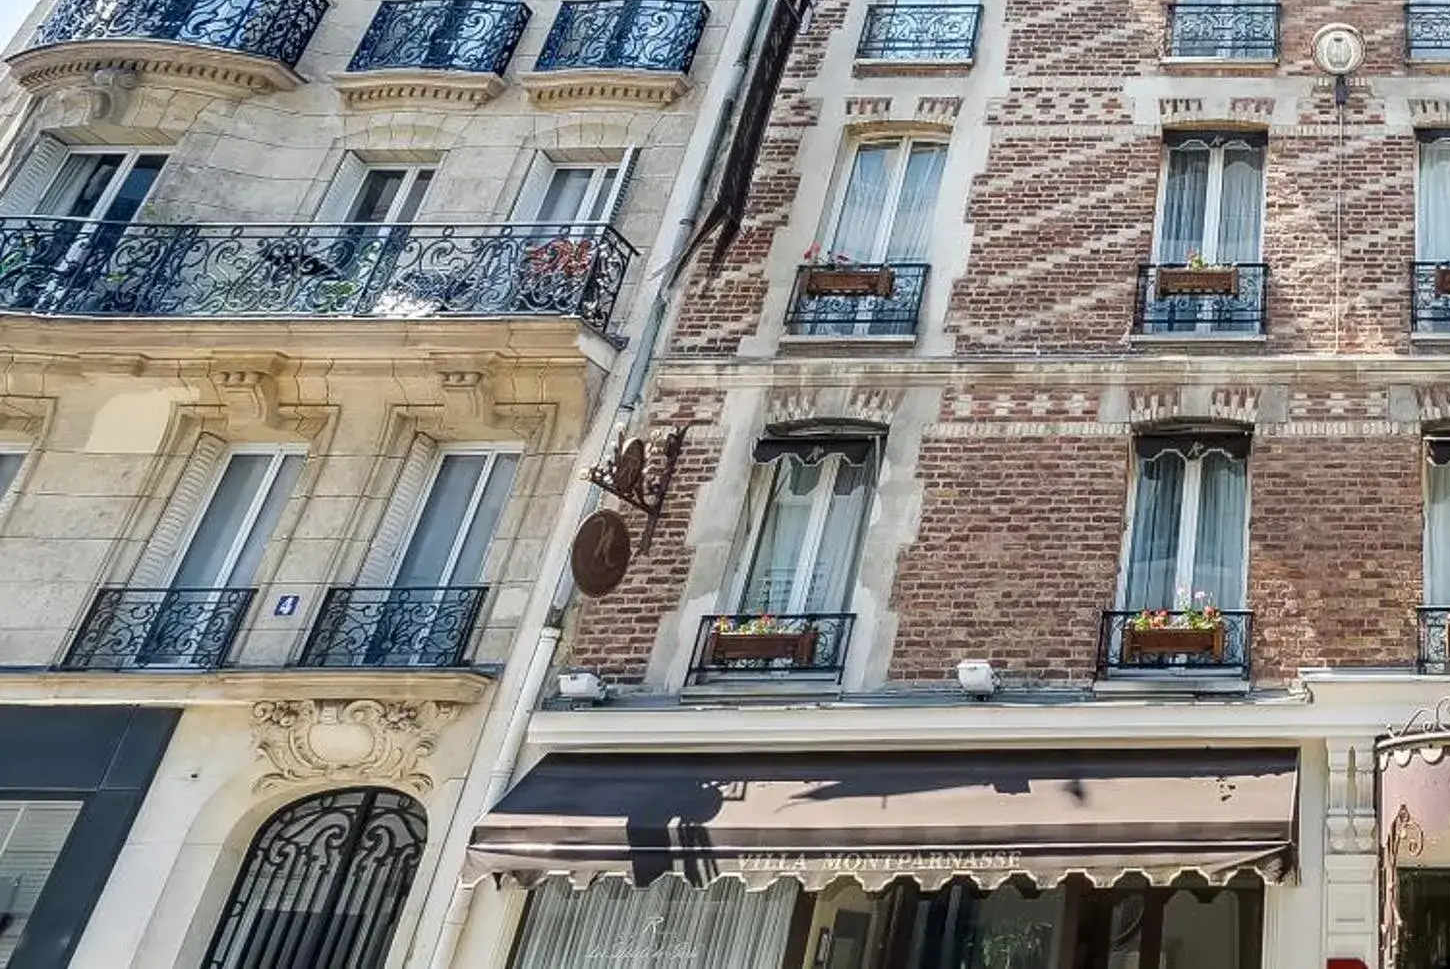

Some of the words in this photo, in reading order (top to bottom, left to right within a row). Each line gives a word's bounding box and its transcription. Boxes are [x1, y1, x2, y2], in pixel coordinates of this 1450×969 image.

[279, 597, 294, 614] 4
[737, 852, 807, 871] VILLA
[821, 850, 1022, 871] MONTPARNASSE
